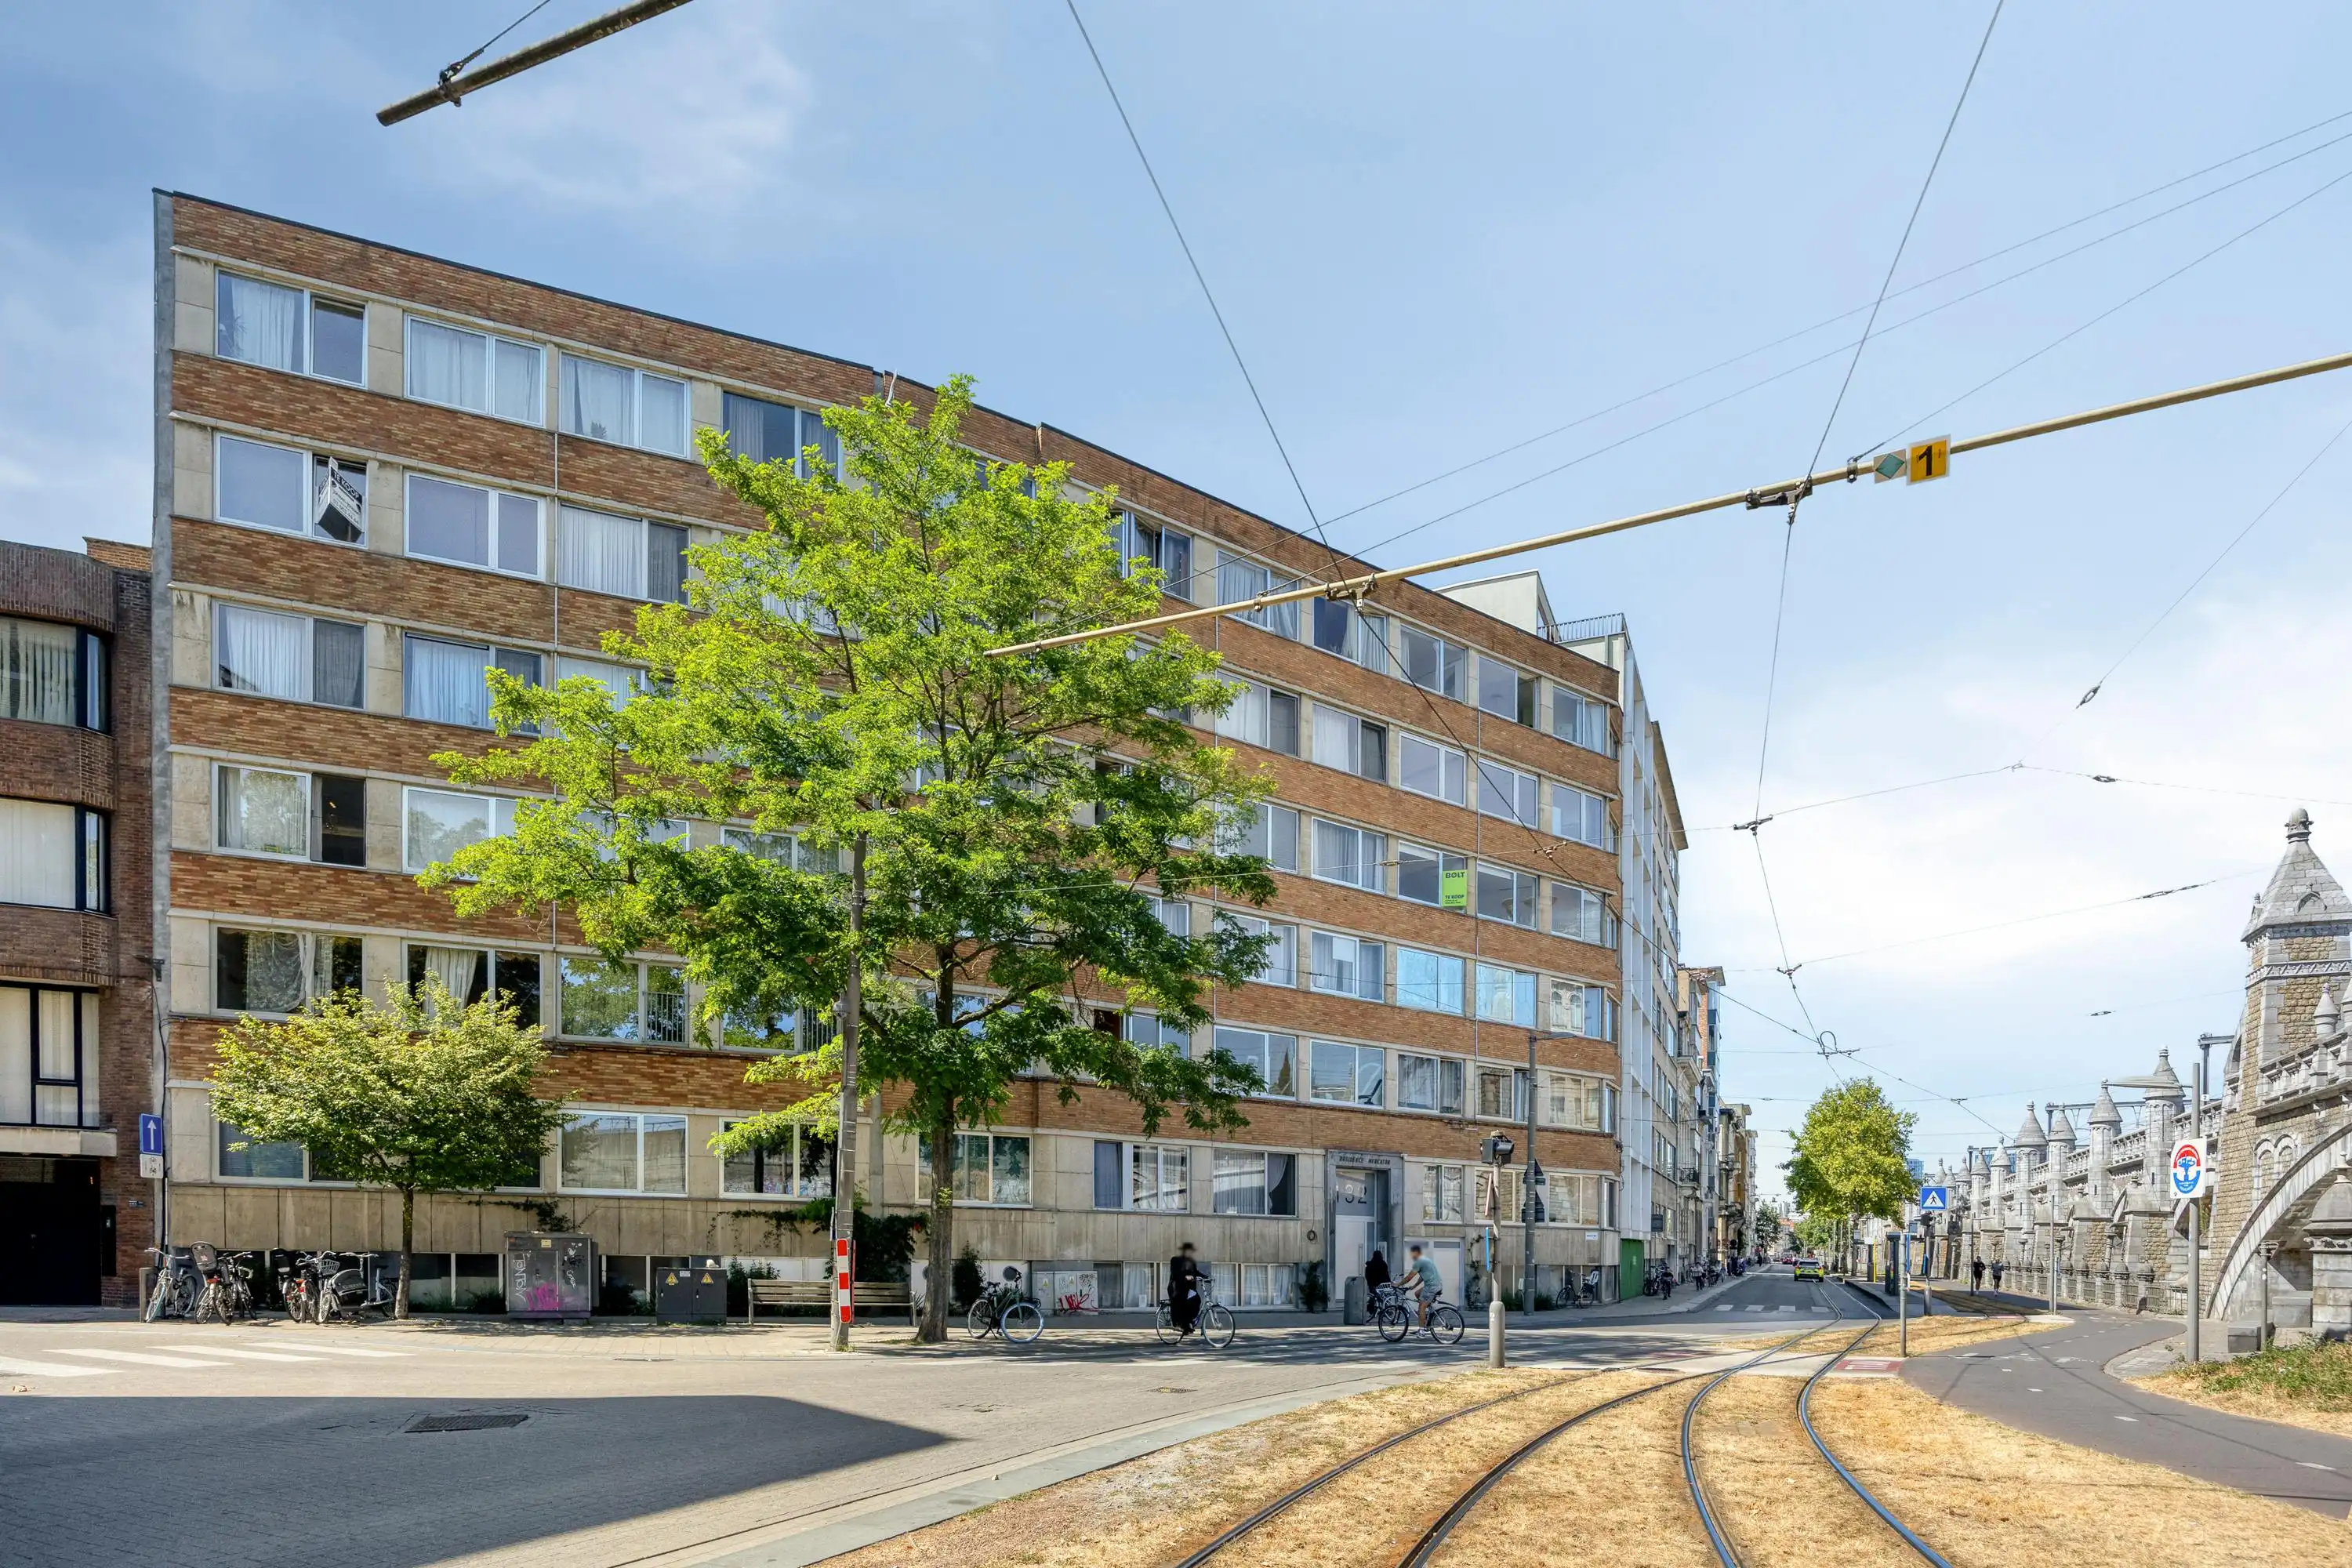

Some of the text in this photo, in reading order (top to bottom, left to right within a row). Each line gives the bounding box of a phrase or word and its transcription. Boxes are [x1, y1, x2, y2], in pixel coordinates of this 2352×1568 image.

[1918, 445, 1933, 477] 1
[333, 471, 341, 483] TE
[341, 478, 359, 499] KOOP
